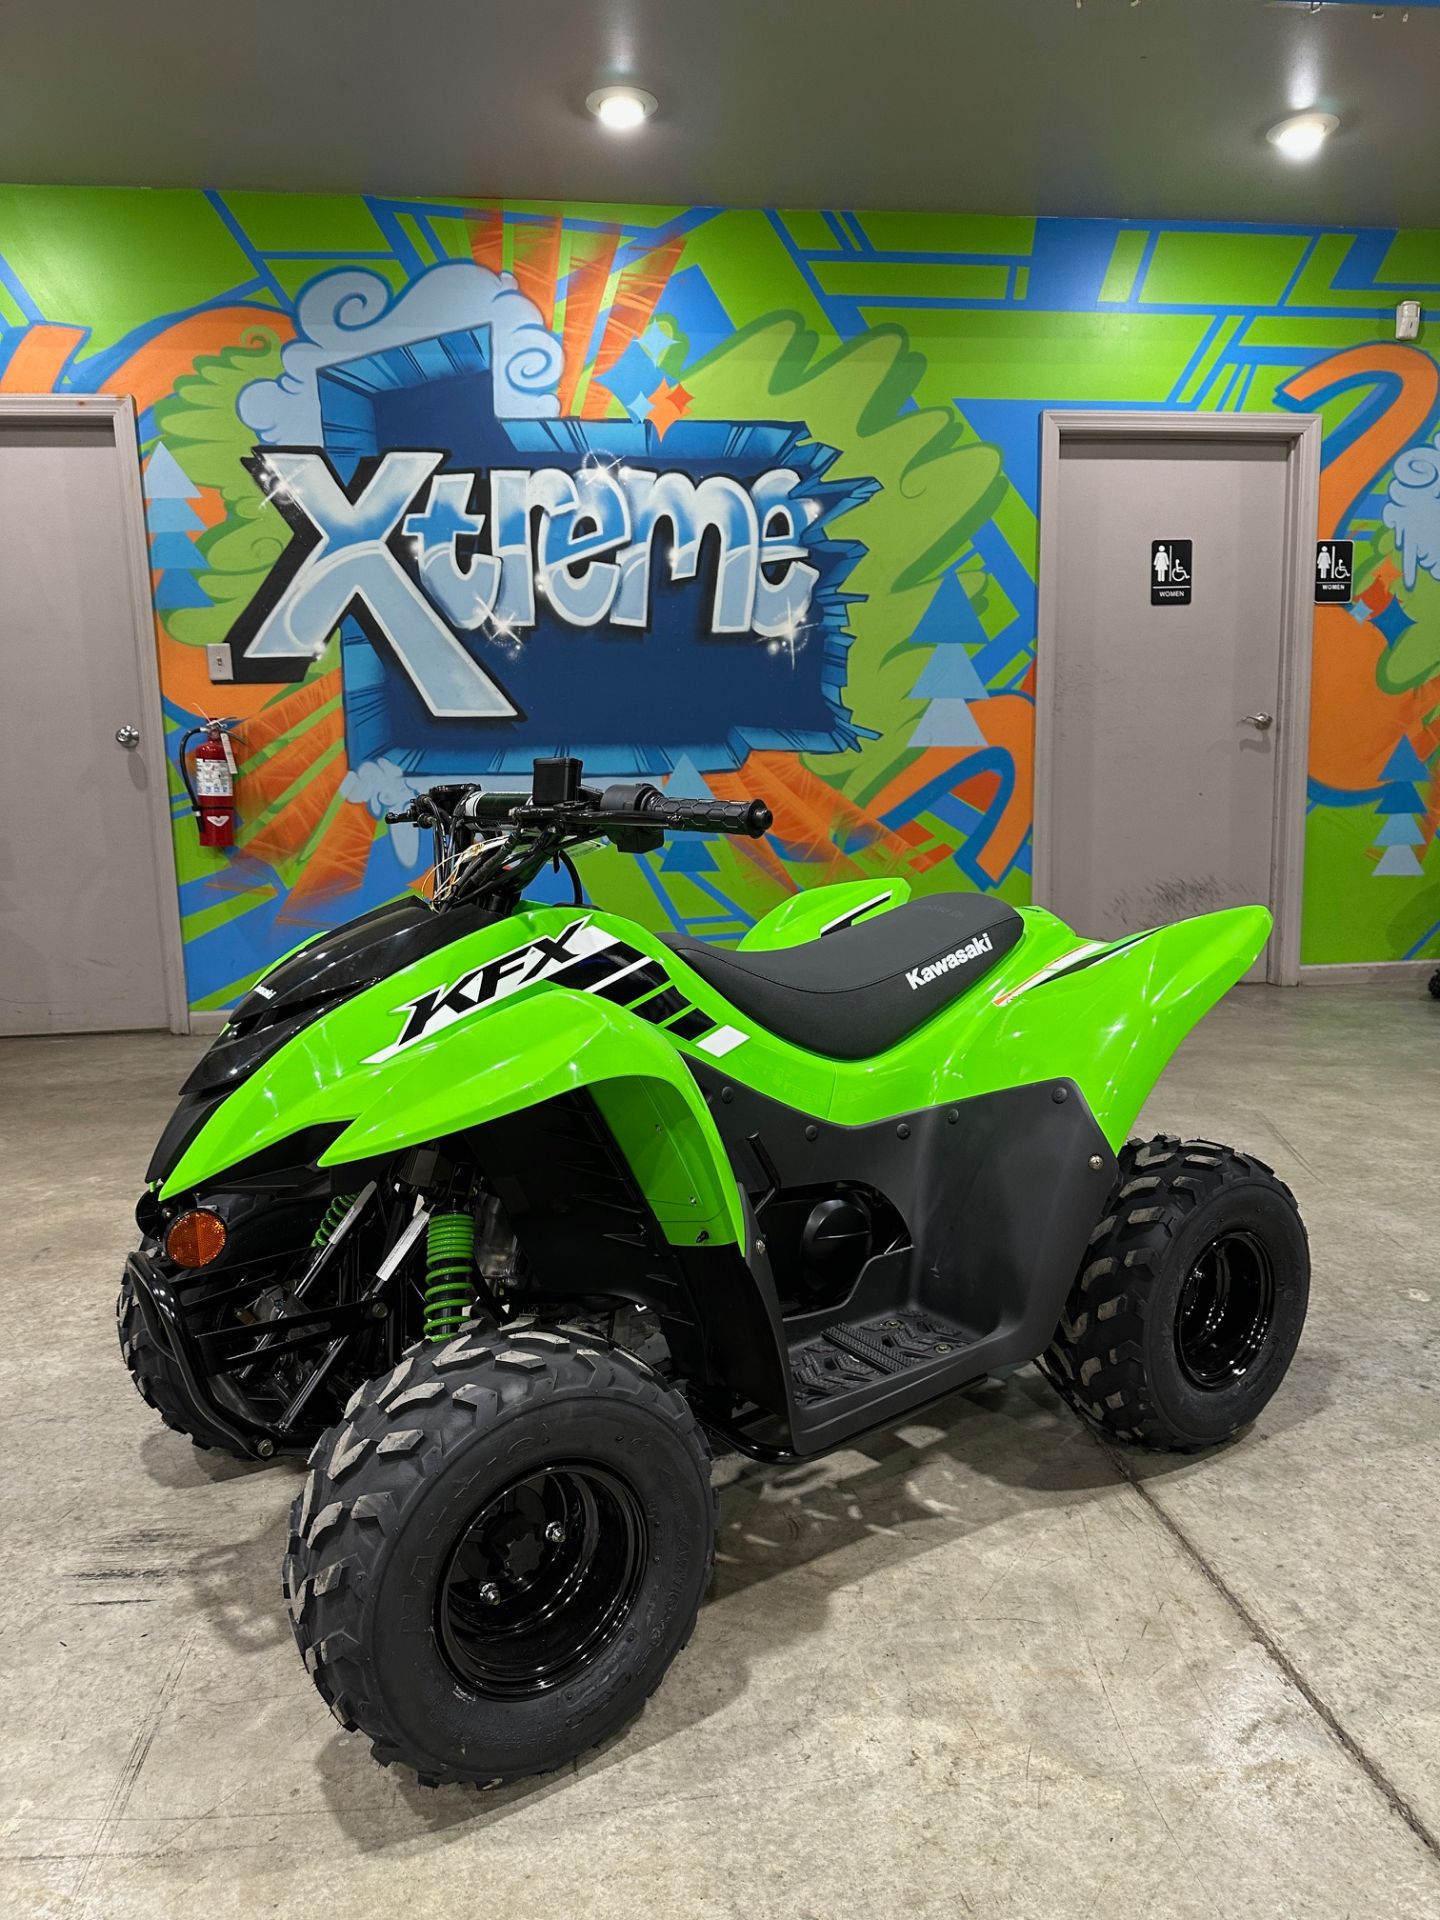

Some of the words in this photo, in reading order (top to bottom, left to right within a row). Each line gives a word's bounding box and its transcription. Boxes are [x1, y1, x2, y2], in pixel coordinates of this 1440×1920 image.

[244, 452, 820, 716] Xtreme
[397, 917, 588, 1048] KFX
[904, 932, 995, 992] Kawasaki
